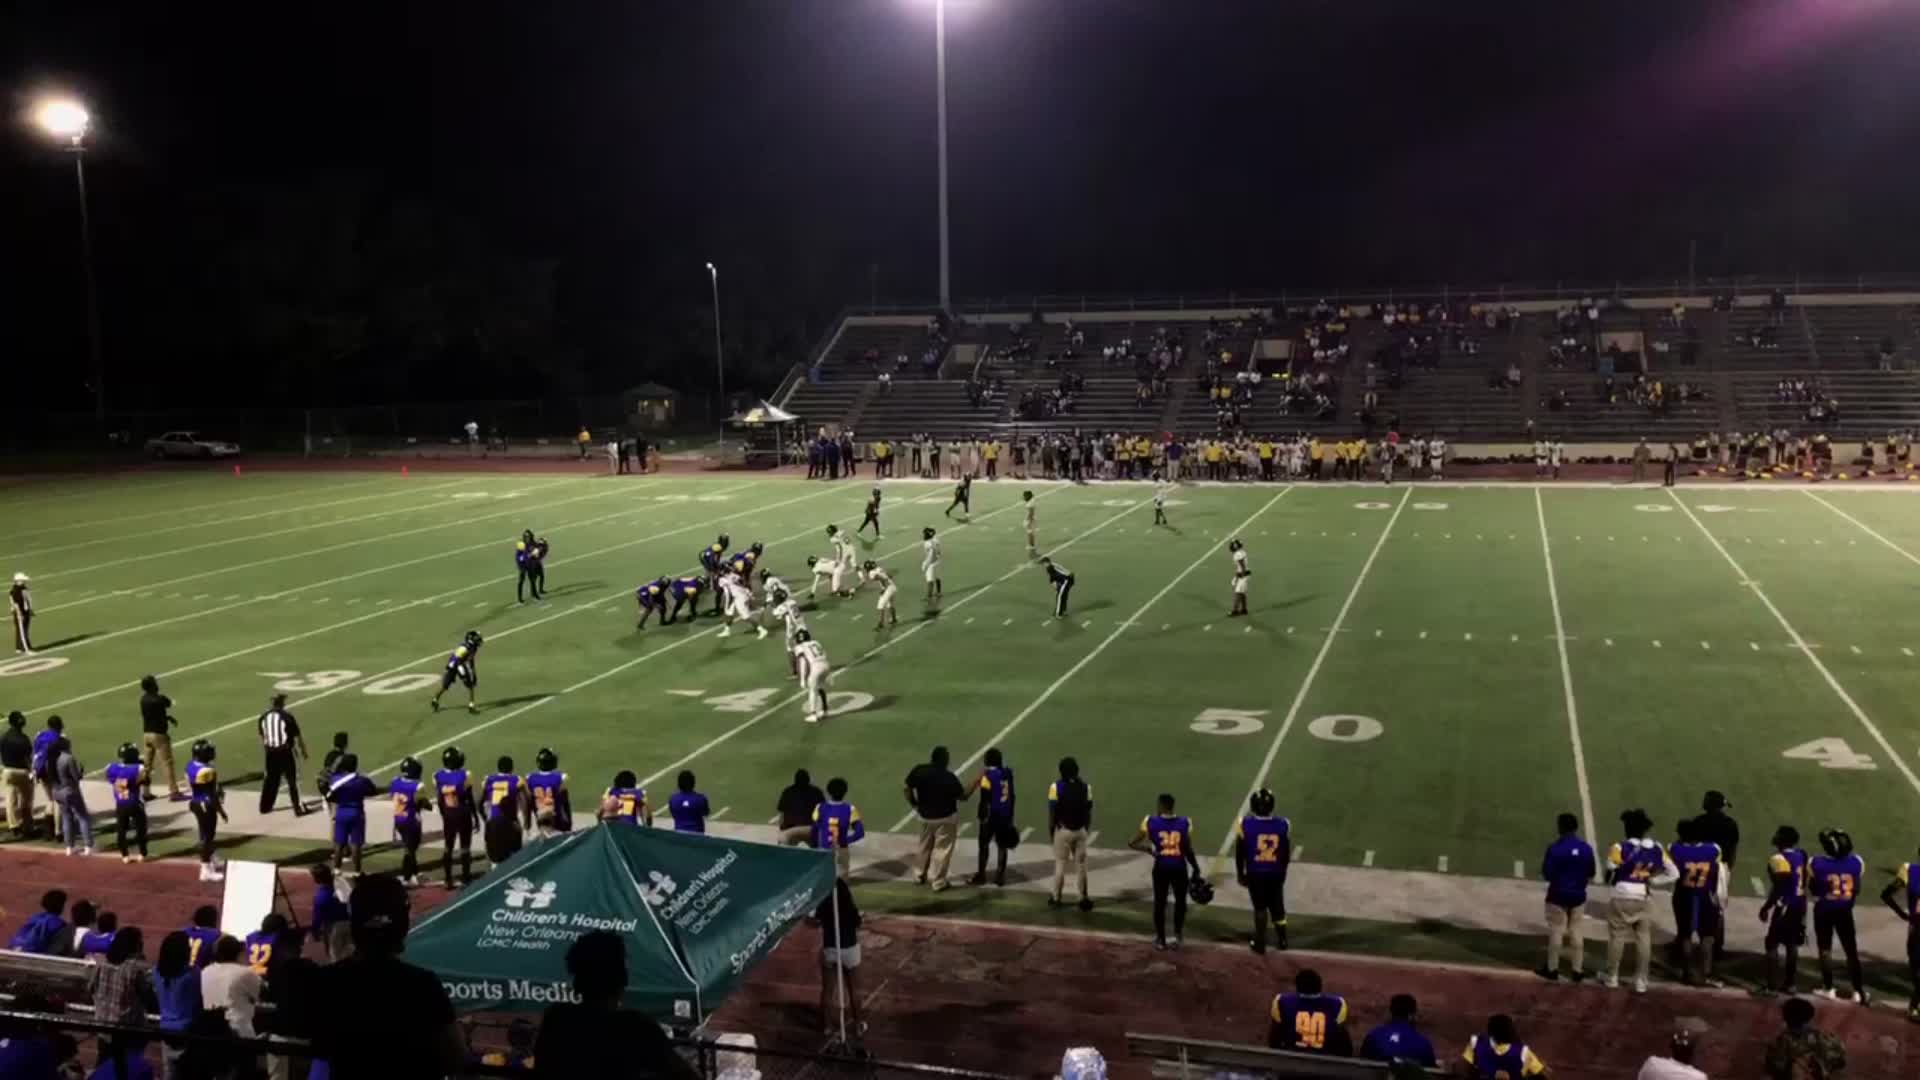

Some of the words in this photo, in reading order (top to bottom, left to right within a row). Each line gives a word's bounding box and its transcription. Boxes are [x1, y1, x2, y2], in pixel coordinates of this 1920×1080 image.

[492, 908, 568, 925] Children's
[571, 913, 638, 932] Hospital
[483, 924, 517, 938] New
[512, 940, 551, 950] Health
